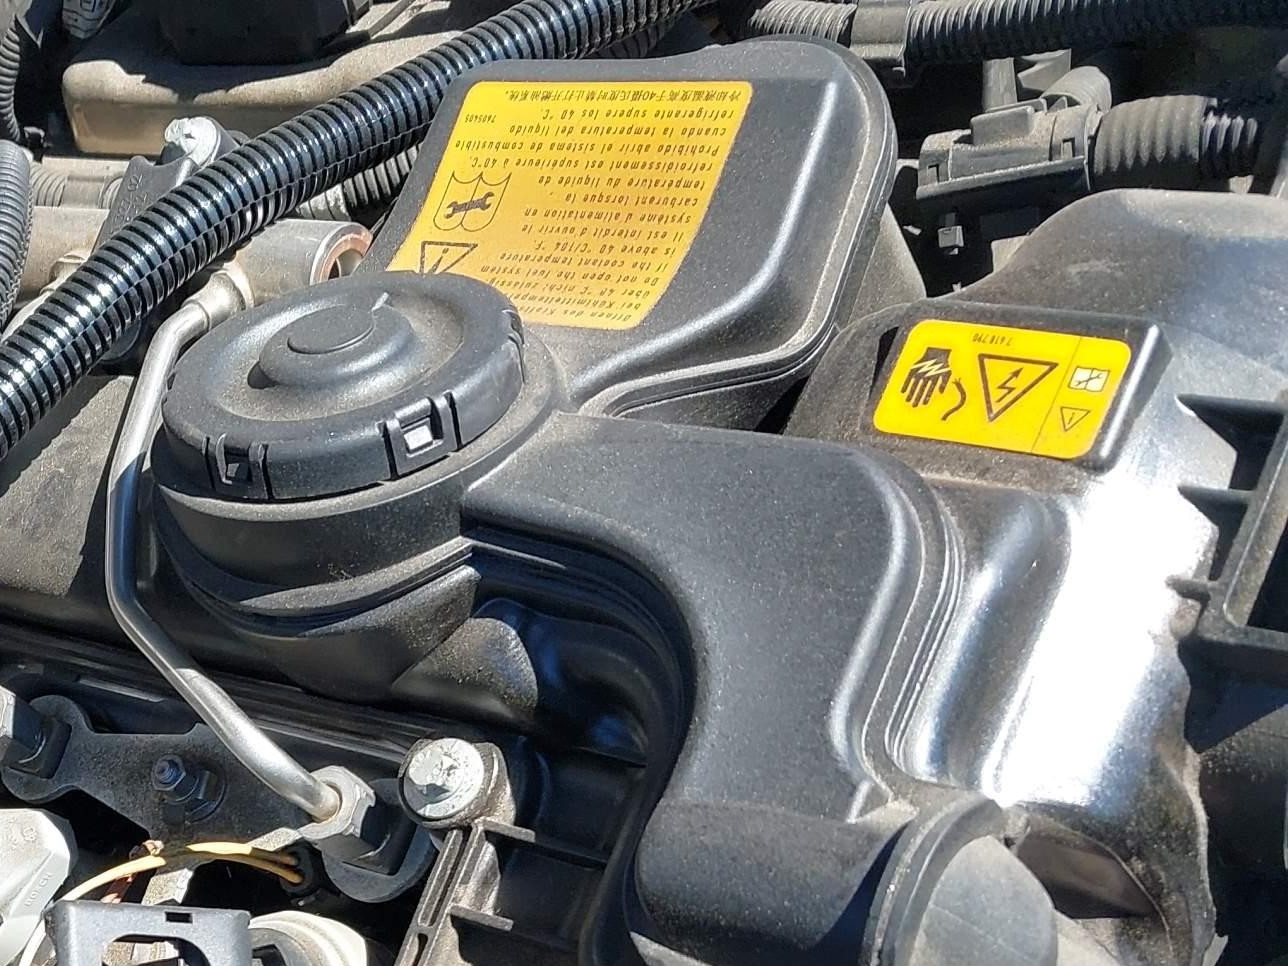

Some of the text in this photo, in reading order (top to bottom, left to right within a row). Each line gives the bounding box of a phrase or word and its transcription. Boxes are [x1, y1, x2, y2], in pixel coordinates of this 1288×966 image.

[560, 110, 575, 120] 40
[579, 109, 600, 121] los
[605, 107, 648, 118] supere
[653, 107, 735, 121] refrigerante
[554, 126, 574, 137] del
[579, 124, 658, 138] temperatura
[660, 128, 675, 138] la
[679, 127, 727, 139] cuando
[453, 141, 720, 157] Prohibido abrir el sistema de combustible
[513, 156, 580, 172] supérieure
[584, 160, 604, 171] est
[608, 161, 712, 175] refroidissement
[537, 174, 707, 193] température du liquide de
[564, 191, 698, 210] carburant lorsque la
[524, 208, 539, 217] en
[639, 211, 694, 226] système
[520, 224, 535, 235] le
[591, 228, 643, 241] interdit
[646, 231, 669, 242] est
[672, 232, 685, 243] Il
[598, 244, 616, 256] 40
[619, 245, 659, 257] above
[663, 248, 677, 258] is
[499, 251, 669, 273] if the coolant temperature
[480, 265, 660, 287] Do not open the fuel system
[542, 283, 576, 294] nicht
[580, 287, 594, 296] °C
[599, 288, 616, 298] 40
[620, 289, 651, 300] über
[620, 302, 642, 312] bei
[563, 310, 585, 319] des
